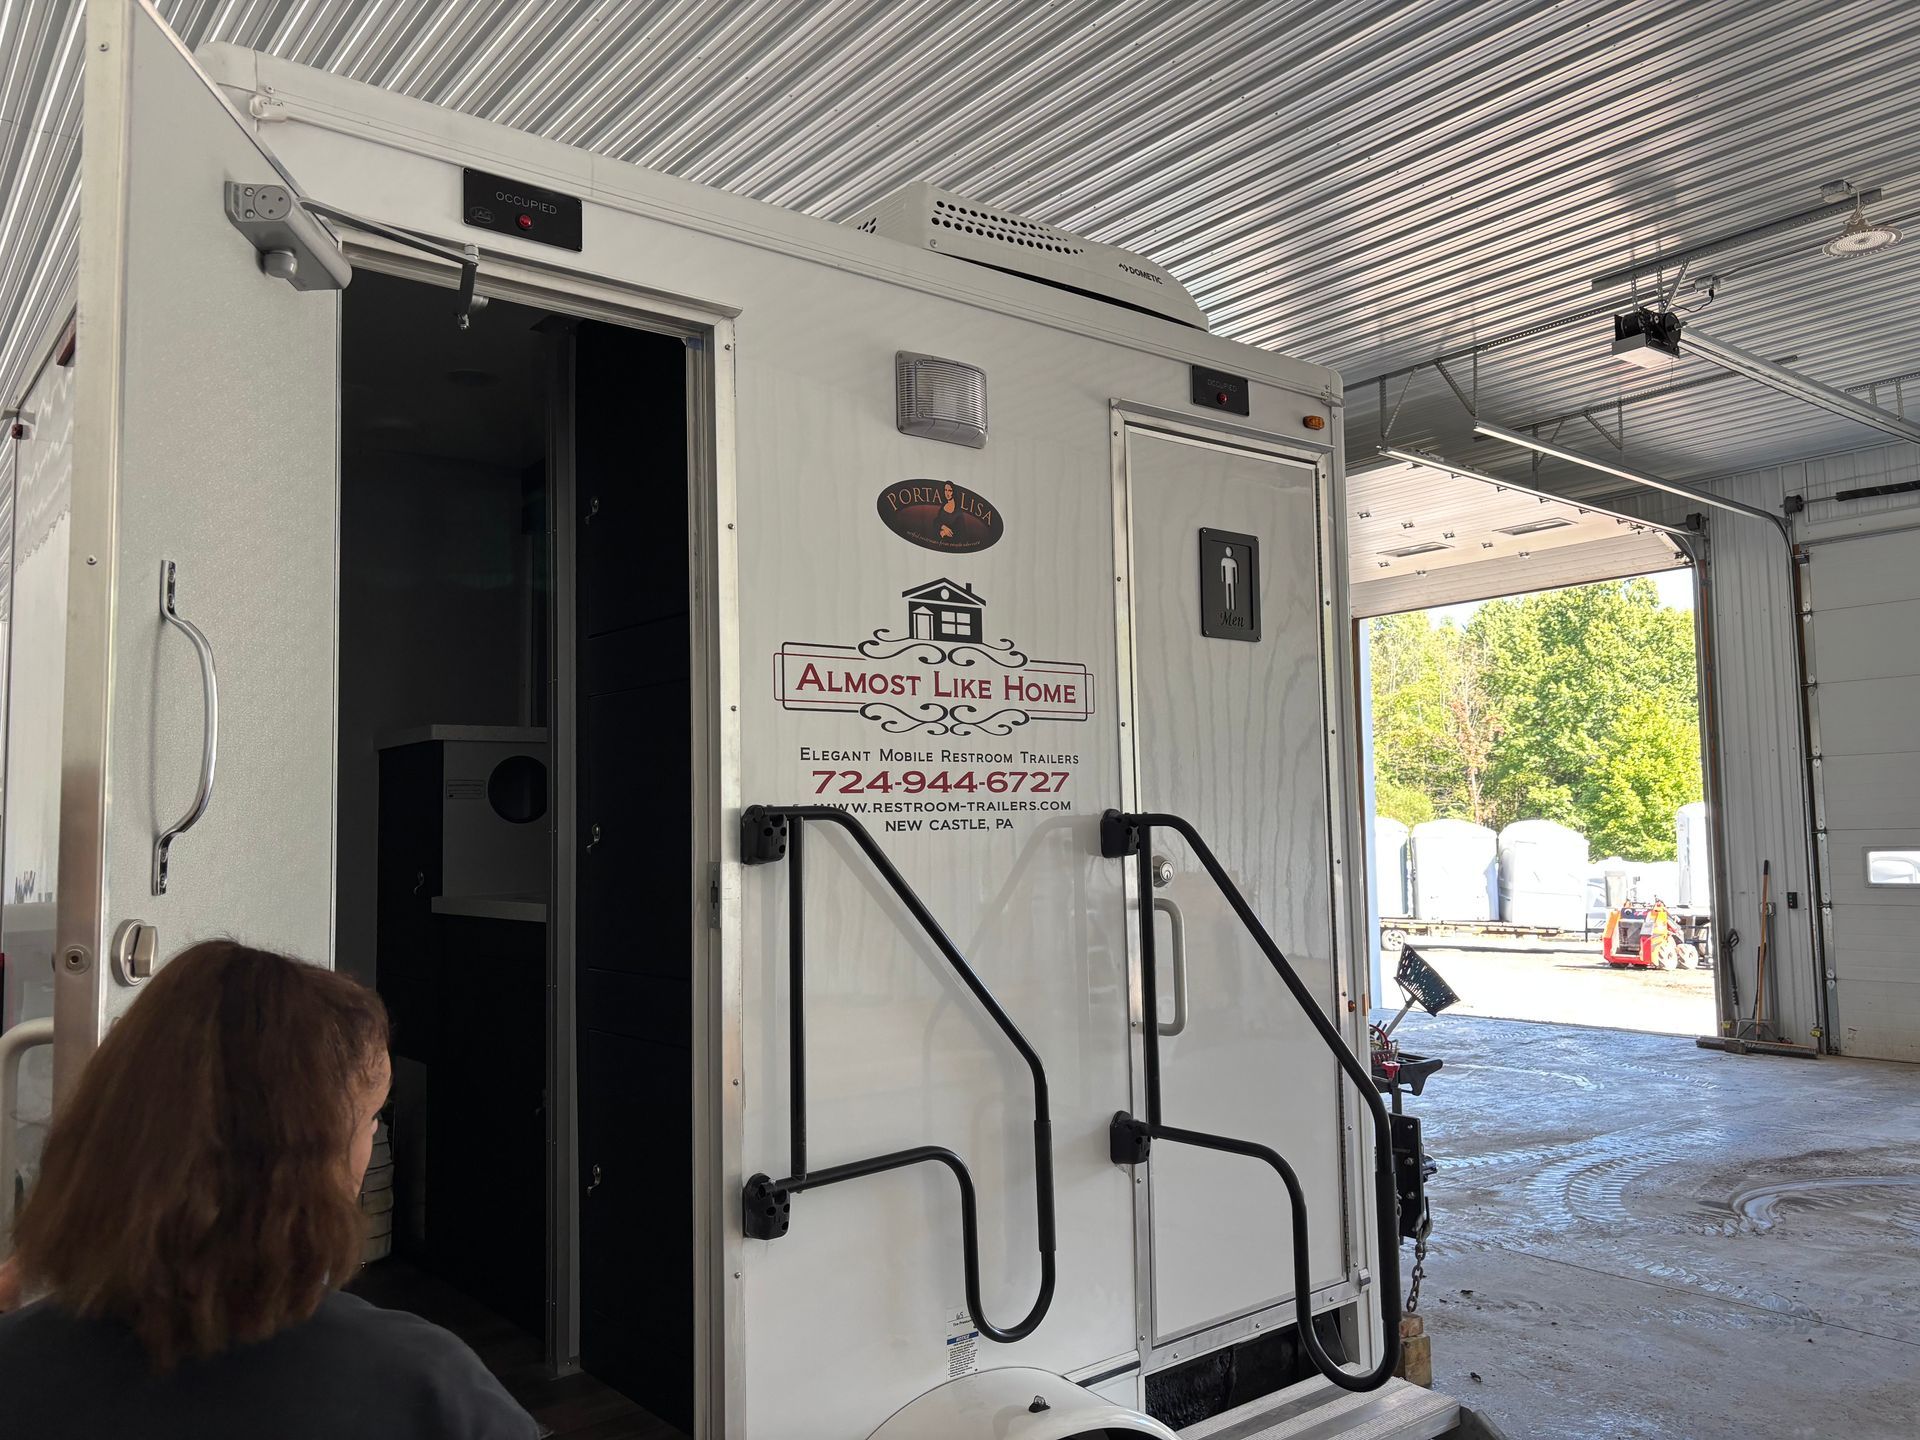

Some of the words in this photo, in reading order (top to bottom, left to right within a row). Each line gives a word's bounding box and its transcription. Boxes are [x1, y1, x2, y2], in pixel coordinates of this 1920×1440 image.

[495, 191, 557, 214] OCCUPIED
[1129, 266, 1163, 285] DOMETIC
[887, 487, 943, 511] PORTA
[961, 492, 992, 526] LISA
[1220, 611, 1244, 628] Men
[796, 662, 921, 696] ALMOST
[933, 671, 992, 700] LIKE
[1003, 675, 1077, 704] HOME
[800, 747, 871, 761] ELEGANT
[879, 748, 934, 762] MOBILE
[941, 749, 1013, 763] RESTROOM
[1020, 751, 1079, 764] TRAILERS
[812, 770, 1070, 793] 724-944-6727
[814, 801, 1071, 813] WW.RESTROOM-TRAILERS.COM
[885, 819, 923, 832] NEW
[929, 818, 990, 832] CASTLE,
[996, 818, 1014, 830] PA
